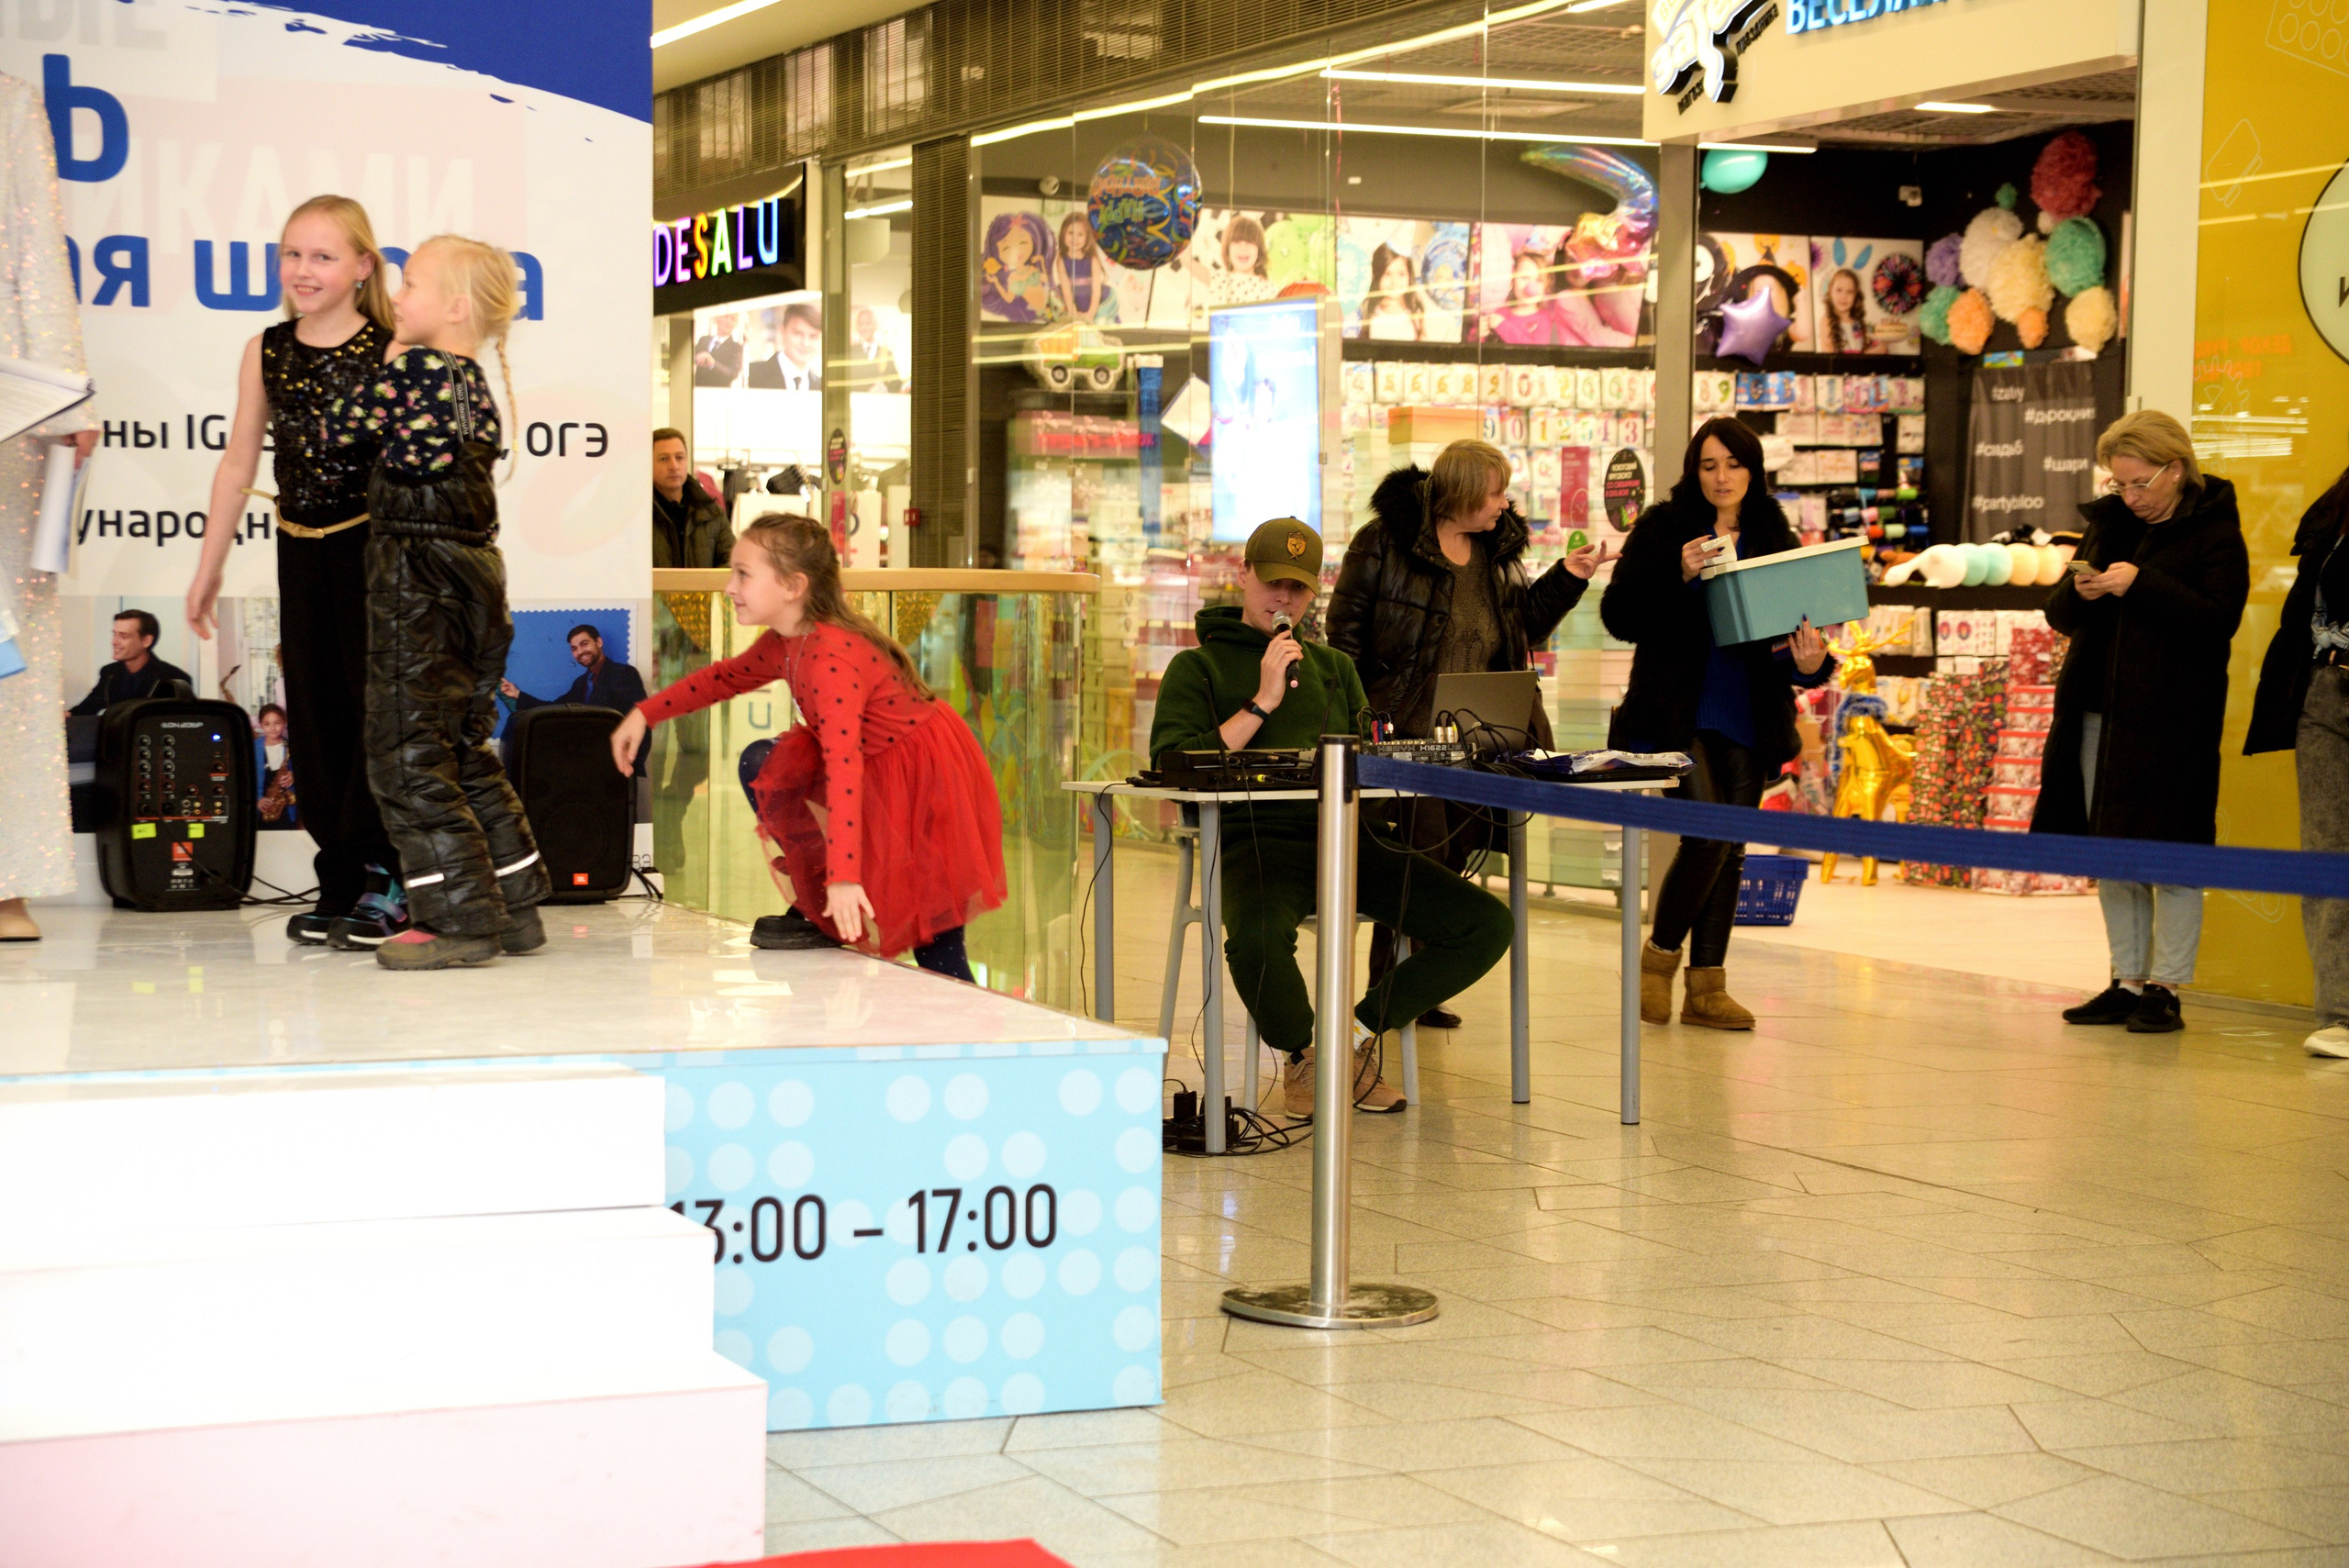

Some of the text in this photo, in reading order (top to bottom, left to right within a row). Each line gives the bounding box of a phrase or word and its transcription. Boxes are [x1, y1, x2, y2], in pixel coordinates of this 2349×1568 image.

[653, 195, 778, 288] DESALU
[526, 421, 609, 459] ОГЭ
[907, 1183, 1057, 1254] 17:00
